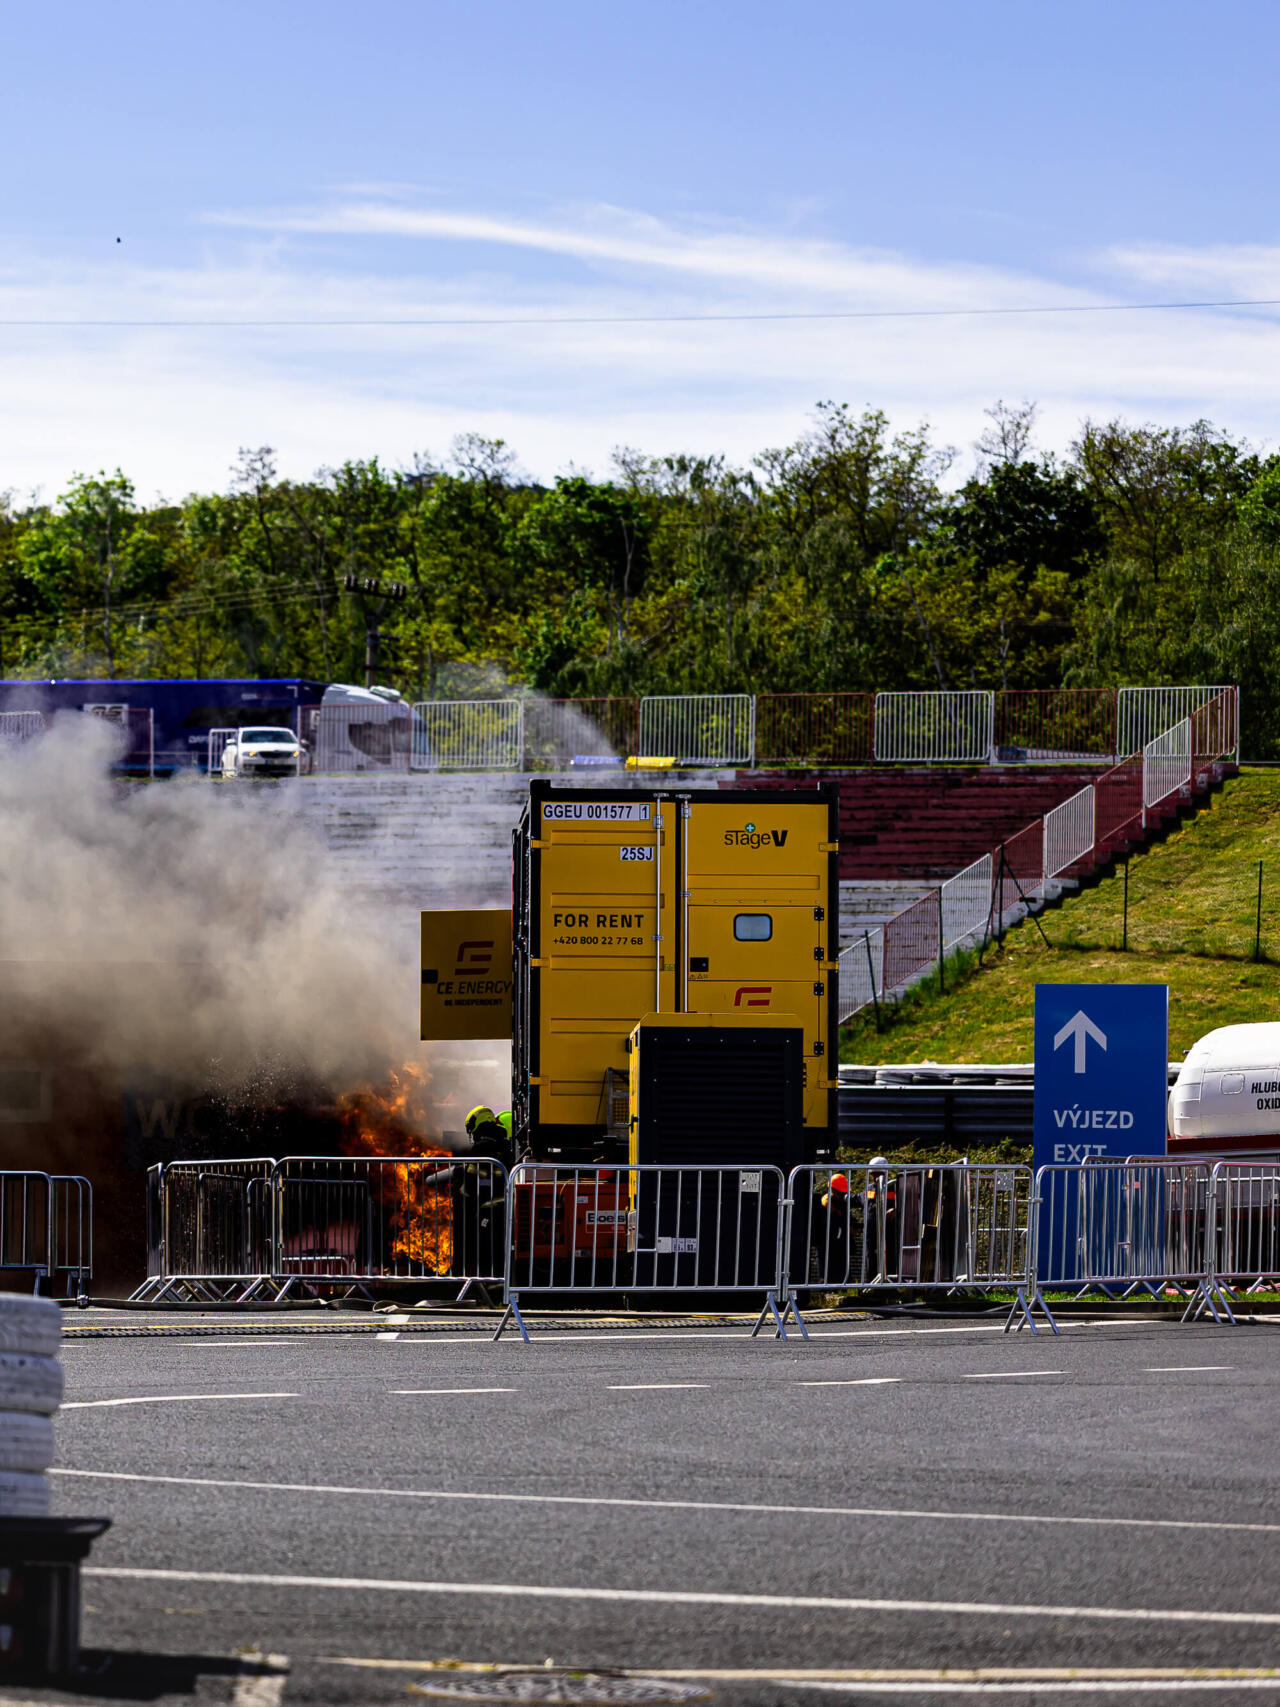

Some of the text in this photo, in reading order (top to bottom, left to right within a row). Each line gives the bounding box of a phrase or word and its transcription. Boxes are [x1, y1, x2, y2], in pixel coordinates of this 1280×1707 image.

[543, 804, 648, 818] GGEU 001577 1
[621, 847, 652, 860] 25SJ
[554, 914, 644, 928] FOR RENT
[553, 936, 643, 945] +420 800 22 77 68
[1053, 1104, 1134, 1129] VÝJEZD
[1054, 1144, 1107, 1162] EXIT
[588, 1212, 625, 1223] Boes
